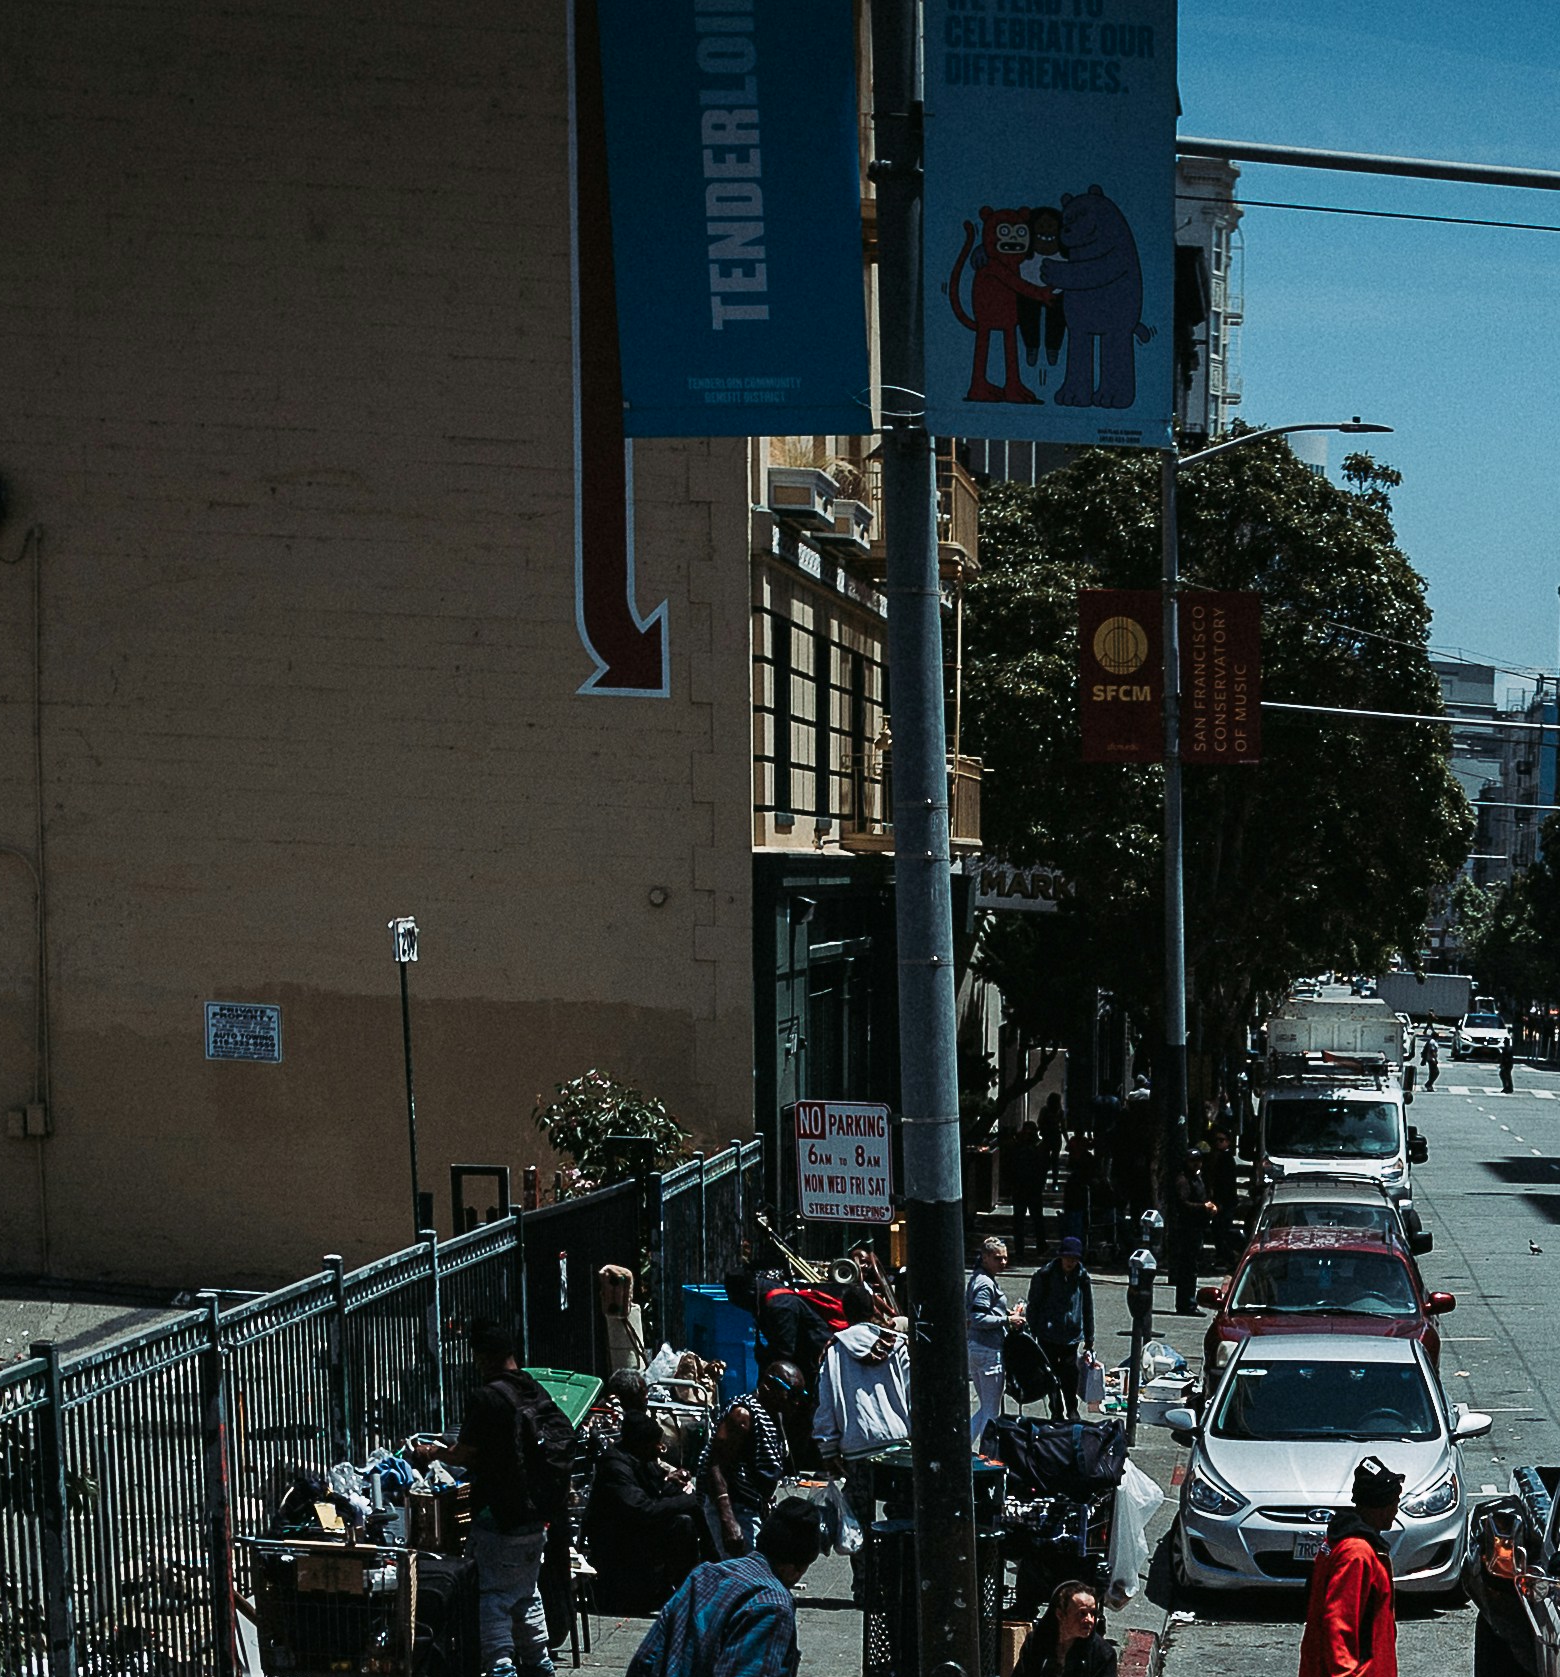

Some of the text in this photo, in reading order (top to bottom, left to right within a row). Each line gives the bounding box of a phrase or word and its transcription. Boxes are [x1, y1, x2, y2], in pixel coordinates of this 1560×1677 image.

[945, 16, 1154, 58] CELEBRATE OUR
[945, 54, 1129, 94] DIFFERENCES.
[687, 377, 801, 389] TENDERLOIN COMMUNITY
[705, 391, 785, 402] BENEFIT DISTRICT
[1193, 606, 1206, 752] SAN FRANCISCO
[1213, 608, 1226, 751] CONSERVATORY
[1092, 685, 1151, 701] SFCM
[1235, 664, 1247, 752] OF MUSIC
[212, 1012, 273, 1021] PROPERTY
[213, 1032, 275, 1042] AUTO TOWING
[799, 1106, 885, 1138] NO PARKING
[839, 1157, 847, 1166] TO
[804, 1174, 886, 1196] MON WED FRI SAT
[809, 1202, 885, 1217] STREET SWEEPING
